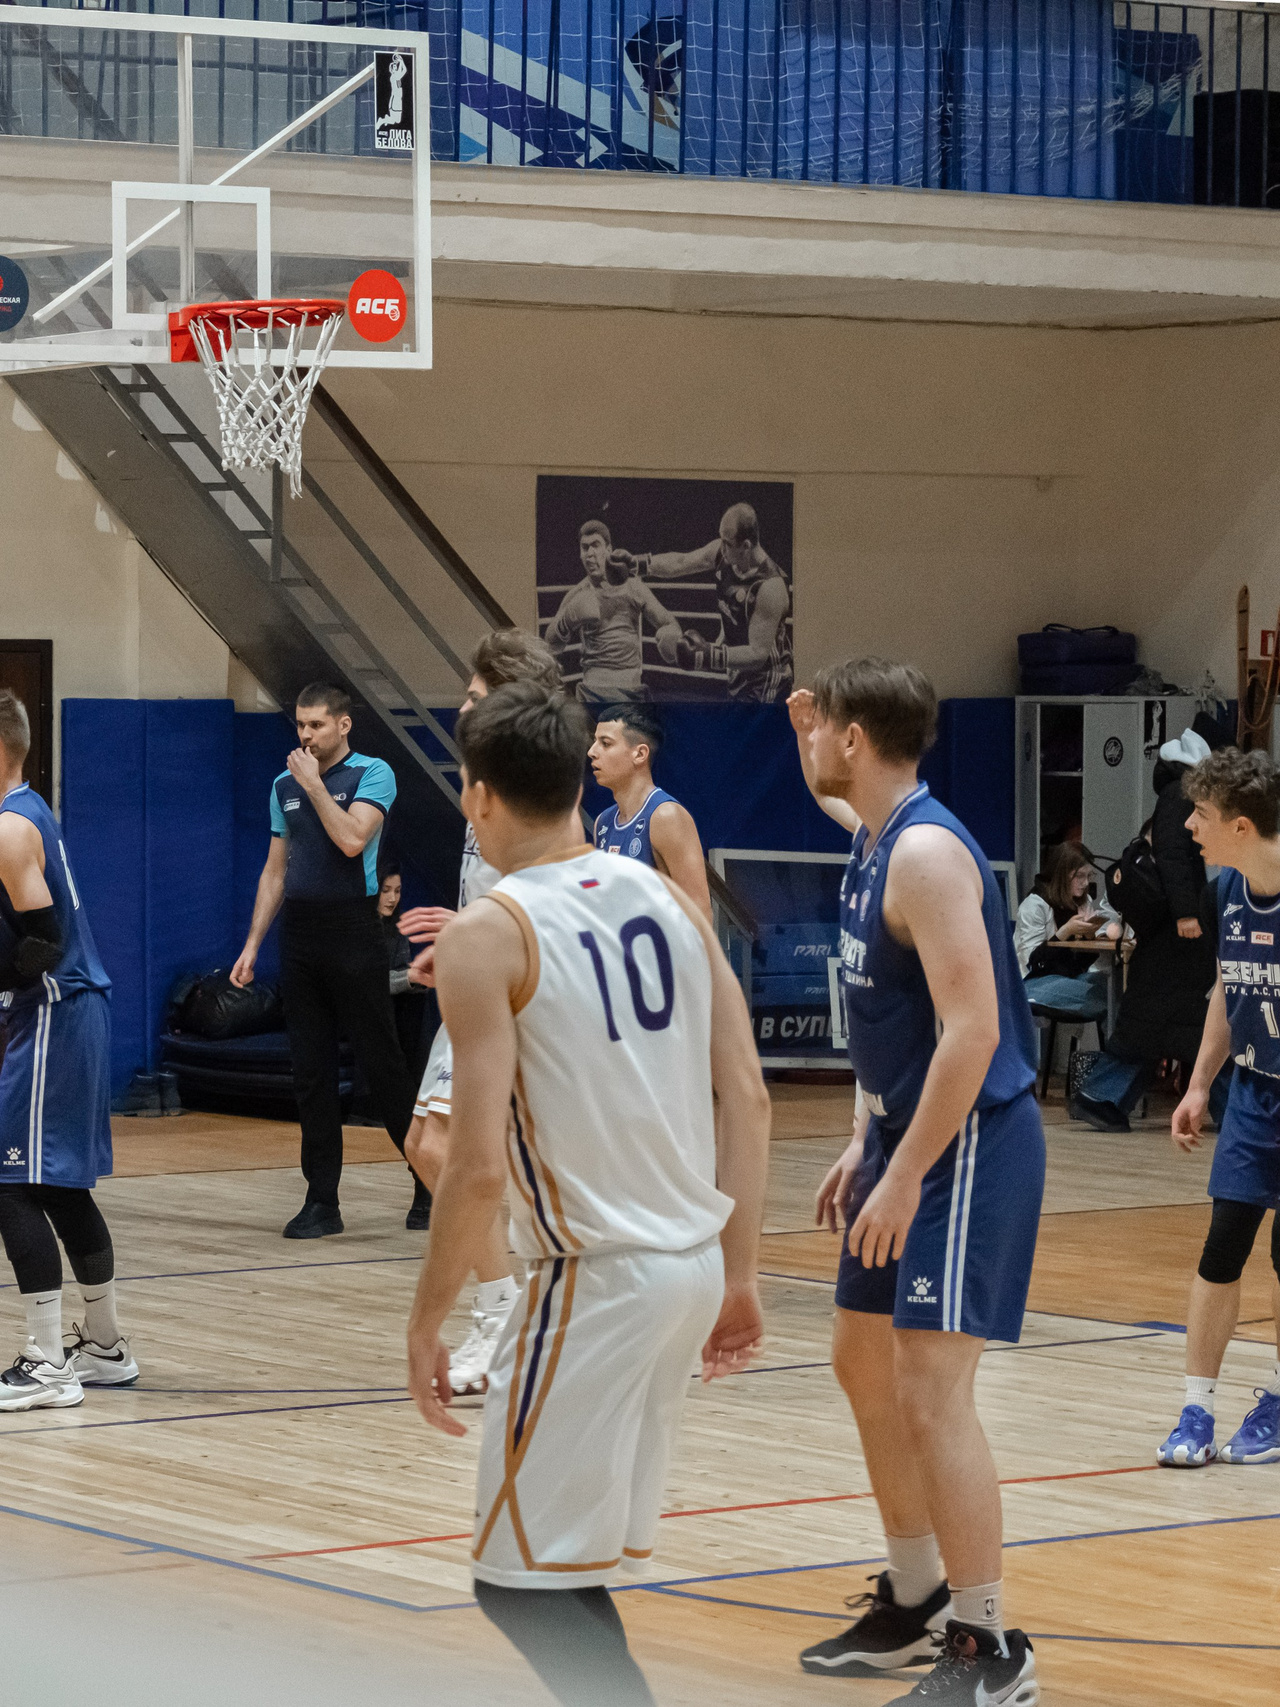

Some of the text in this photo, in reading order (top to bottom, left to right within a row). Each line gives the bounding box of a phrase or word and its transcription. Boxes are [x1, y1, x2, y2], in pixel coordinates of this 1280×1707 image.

[389, 129, 412, 140] ЛИГА
[376, 137, 413, 148] БЕЛОВА
[356, 297, 400, 321] АСБ
[793, 944, 831, 957] PARI
[577, 914, 675, 1042] 10
[907, 1295, 938, 1303] KELME
